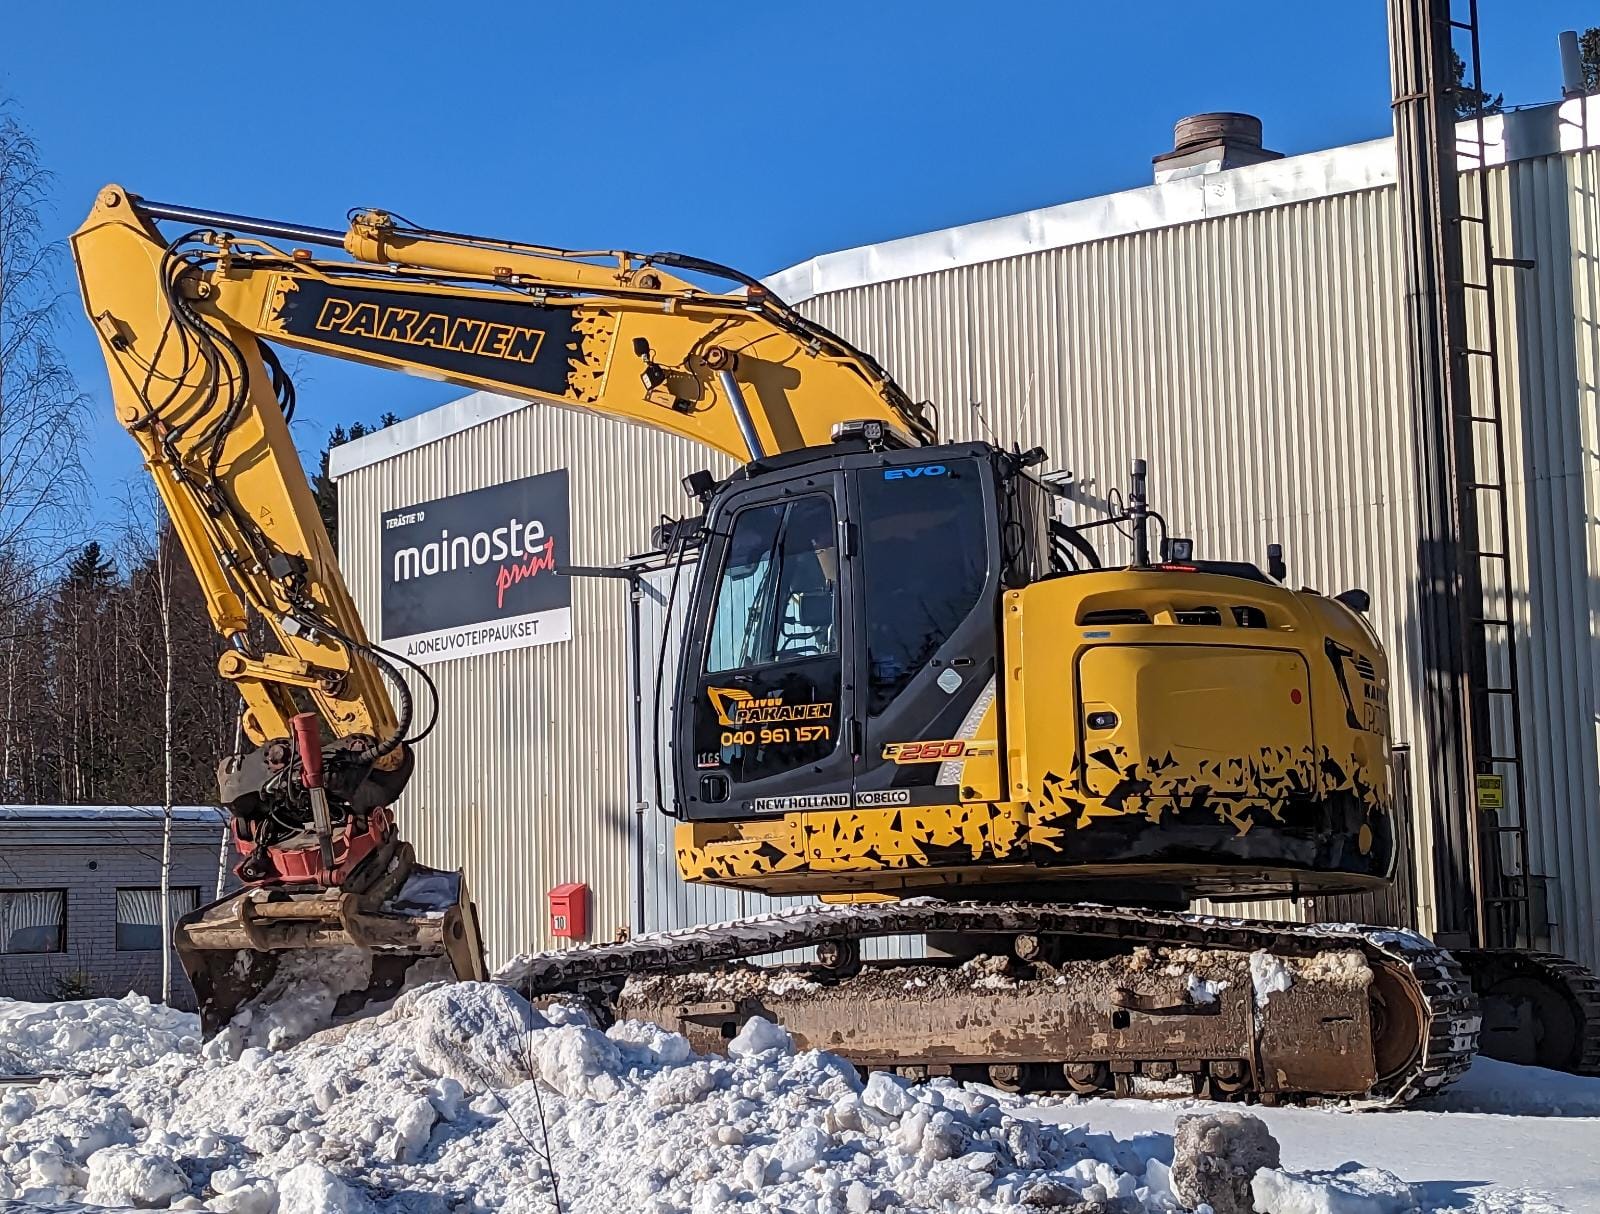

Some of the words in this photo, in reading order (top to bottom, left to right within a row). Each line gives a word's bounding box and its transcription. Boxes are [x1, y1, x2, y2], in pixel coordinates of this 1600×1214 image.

[316, 298, 545, 363] PAKANEN
[884, 465, 946, 480] EVO
[386, 513, 416, 529] TERÄSTIE
[417, 511, 425, 522] 10
[394, 519, 544, 582] mainoste
[496, 536, 554, 608] print
[407, 620, 539, 656] AJONEUVOTEIPPAUKSET
[735, 703, 832, 724] PAKANEN
[721, 731, 755, 747] 040
[760, 728, 790, 744] 961
[795, 725, 829, 741] 1571
[756, 799, 785, 811] NEW
[789, 795, 848, 808] HOLLAND
[857, 791, 908, 804] KOBELCO
[555, 916, 565, 930] 10
